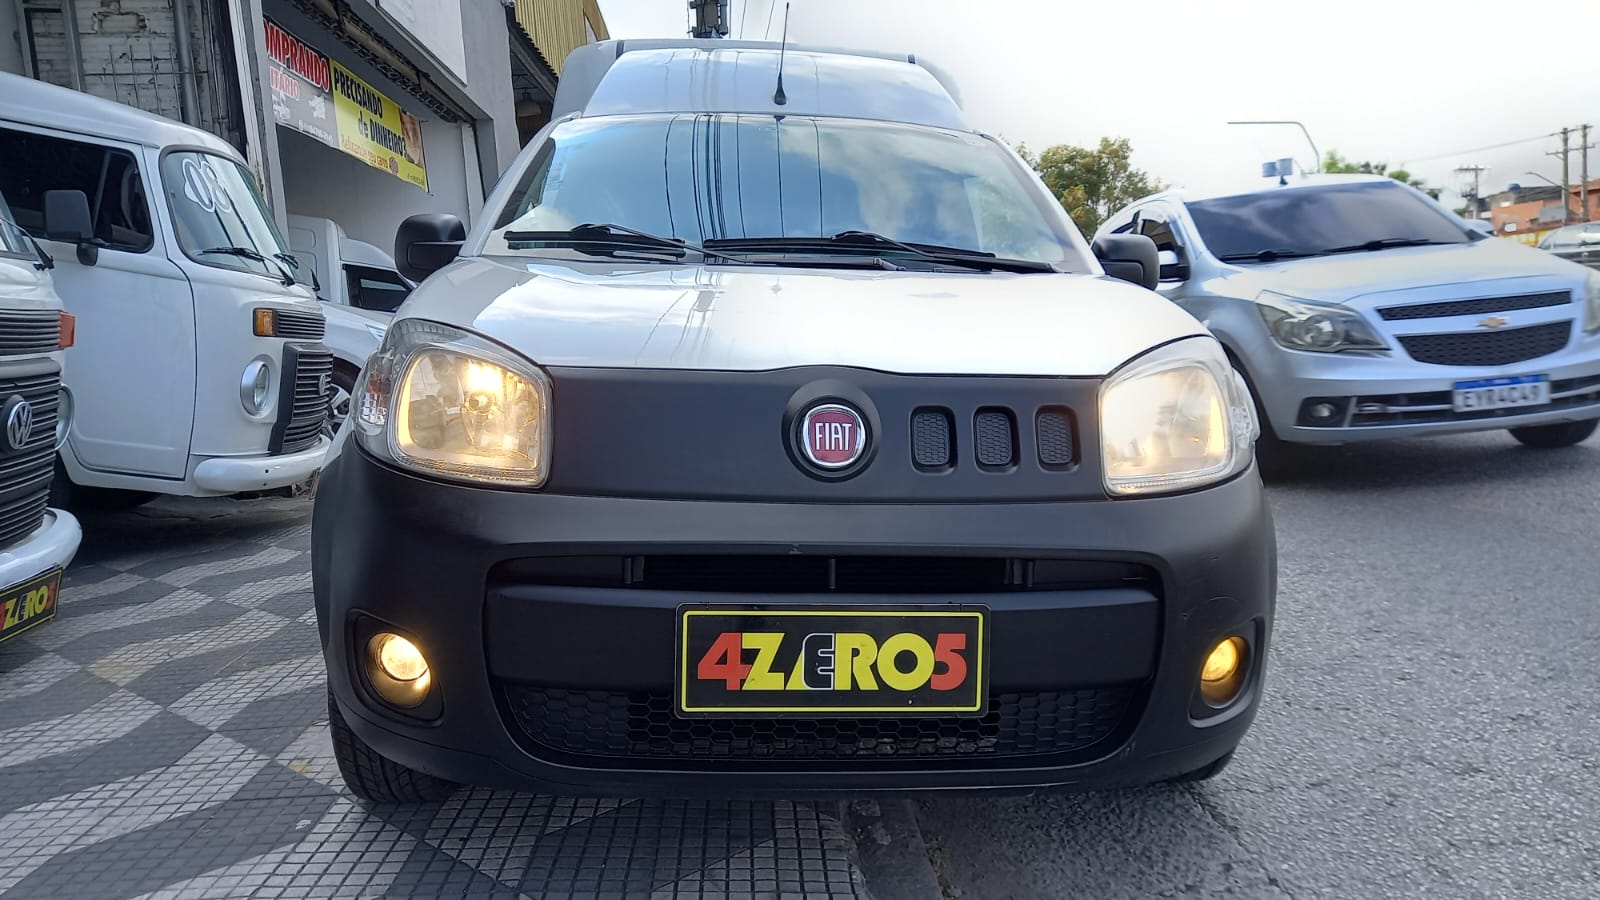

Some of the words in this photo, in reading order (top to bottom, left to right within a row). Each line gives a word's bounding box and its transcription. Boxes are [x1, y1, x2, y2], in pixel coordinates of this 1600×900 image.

[333, 66, 383, 119] PRECISANDO
[358, 110, 368, 139] de
[815, 422, 852, 451] FIAT
[697, 632, 967, 691] 4ZERO5
